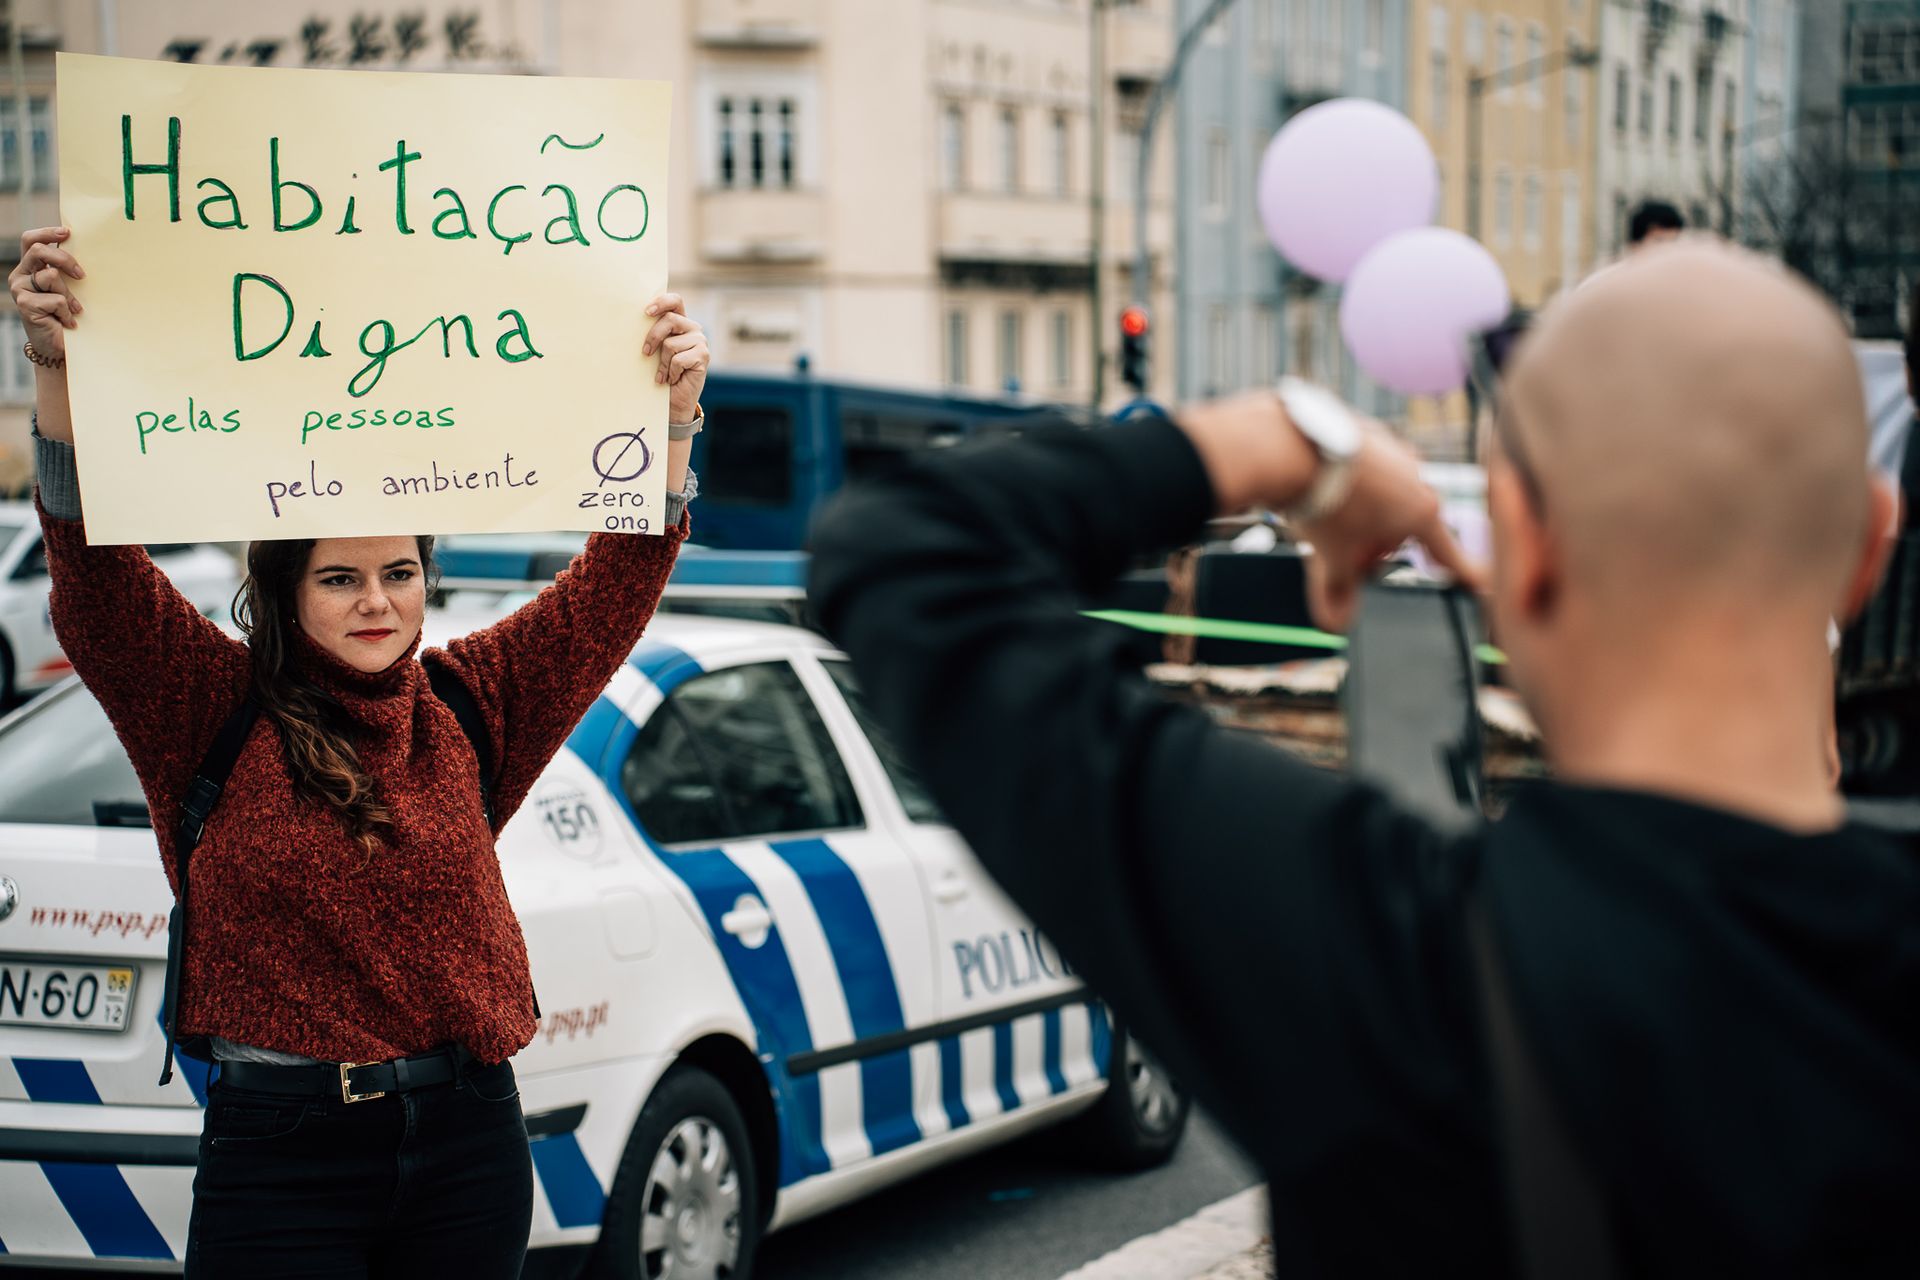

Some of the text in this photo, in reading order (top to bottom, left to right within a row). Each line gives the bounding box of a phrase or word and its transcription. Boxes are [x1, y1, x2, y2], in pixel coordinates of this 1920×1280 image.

[122, 115, 649, 255] Habitação
[232, 272, 544, 398] Digna
[135, 397, 456, 455] pelas pessoas
[266, 452, 539, 517] pelo ambiente
[605, 515, 649, 534] ong
[544, 803, 600, 842] 150
[31, 906, 169, 940] www.psp.p
[537, 1000, 609, 1045] .psp.pt
